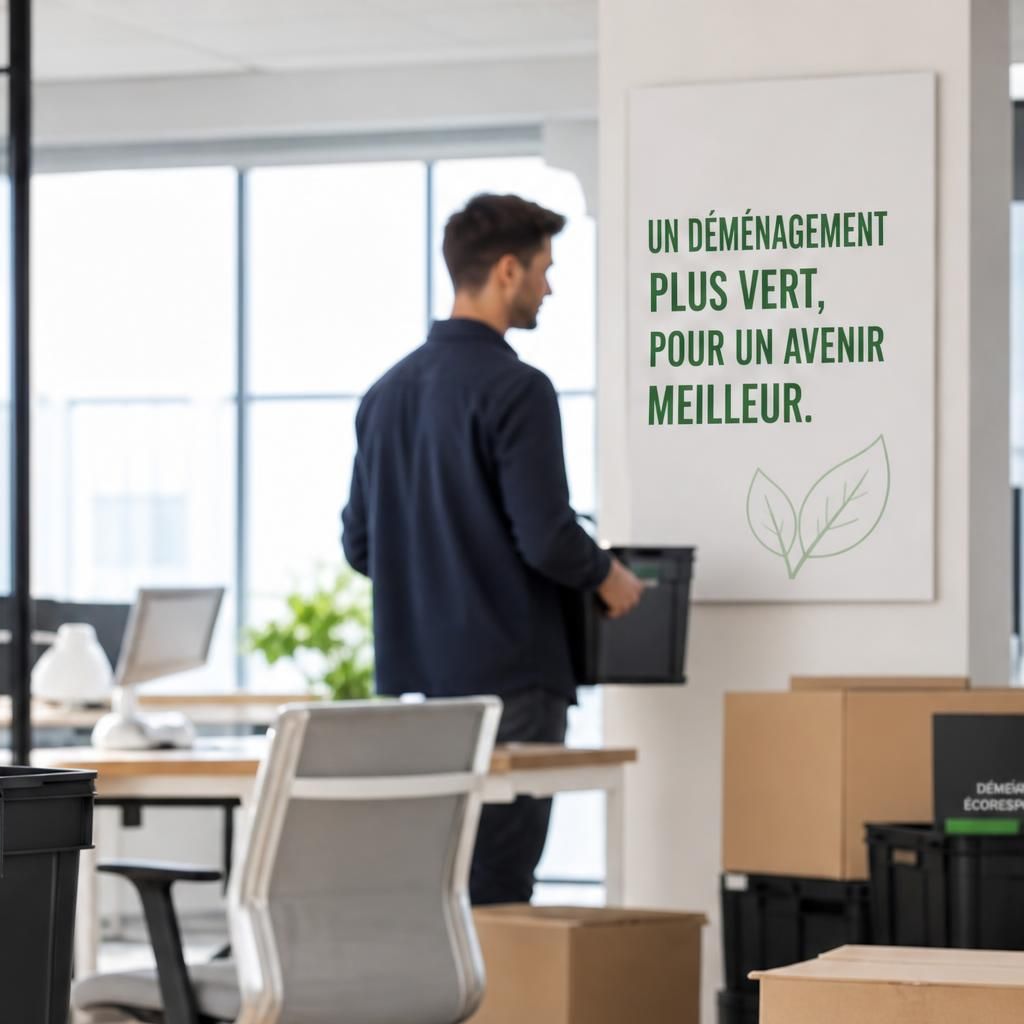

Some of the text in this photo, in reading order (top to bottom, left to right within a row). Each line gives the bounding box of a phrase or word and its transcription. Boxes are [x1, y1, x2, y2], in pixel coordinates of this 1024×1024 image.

[648, 208, 888, 254] UN DÉMÉNAGEMENT
[650, 267, 825, 315] PLUS VERT,
[650, 325, 885, 368] POUR UN AVENIR
[648, 382, 812, 426] MEILLEUR.
